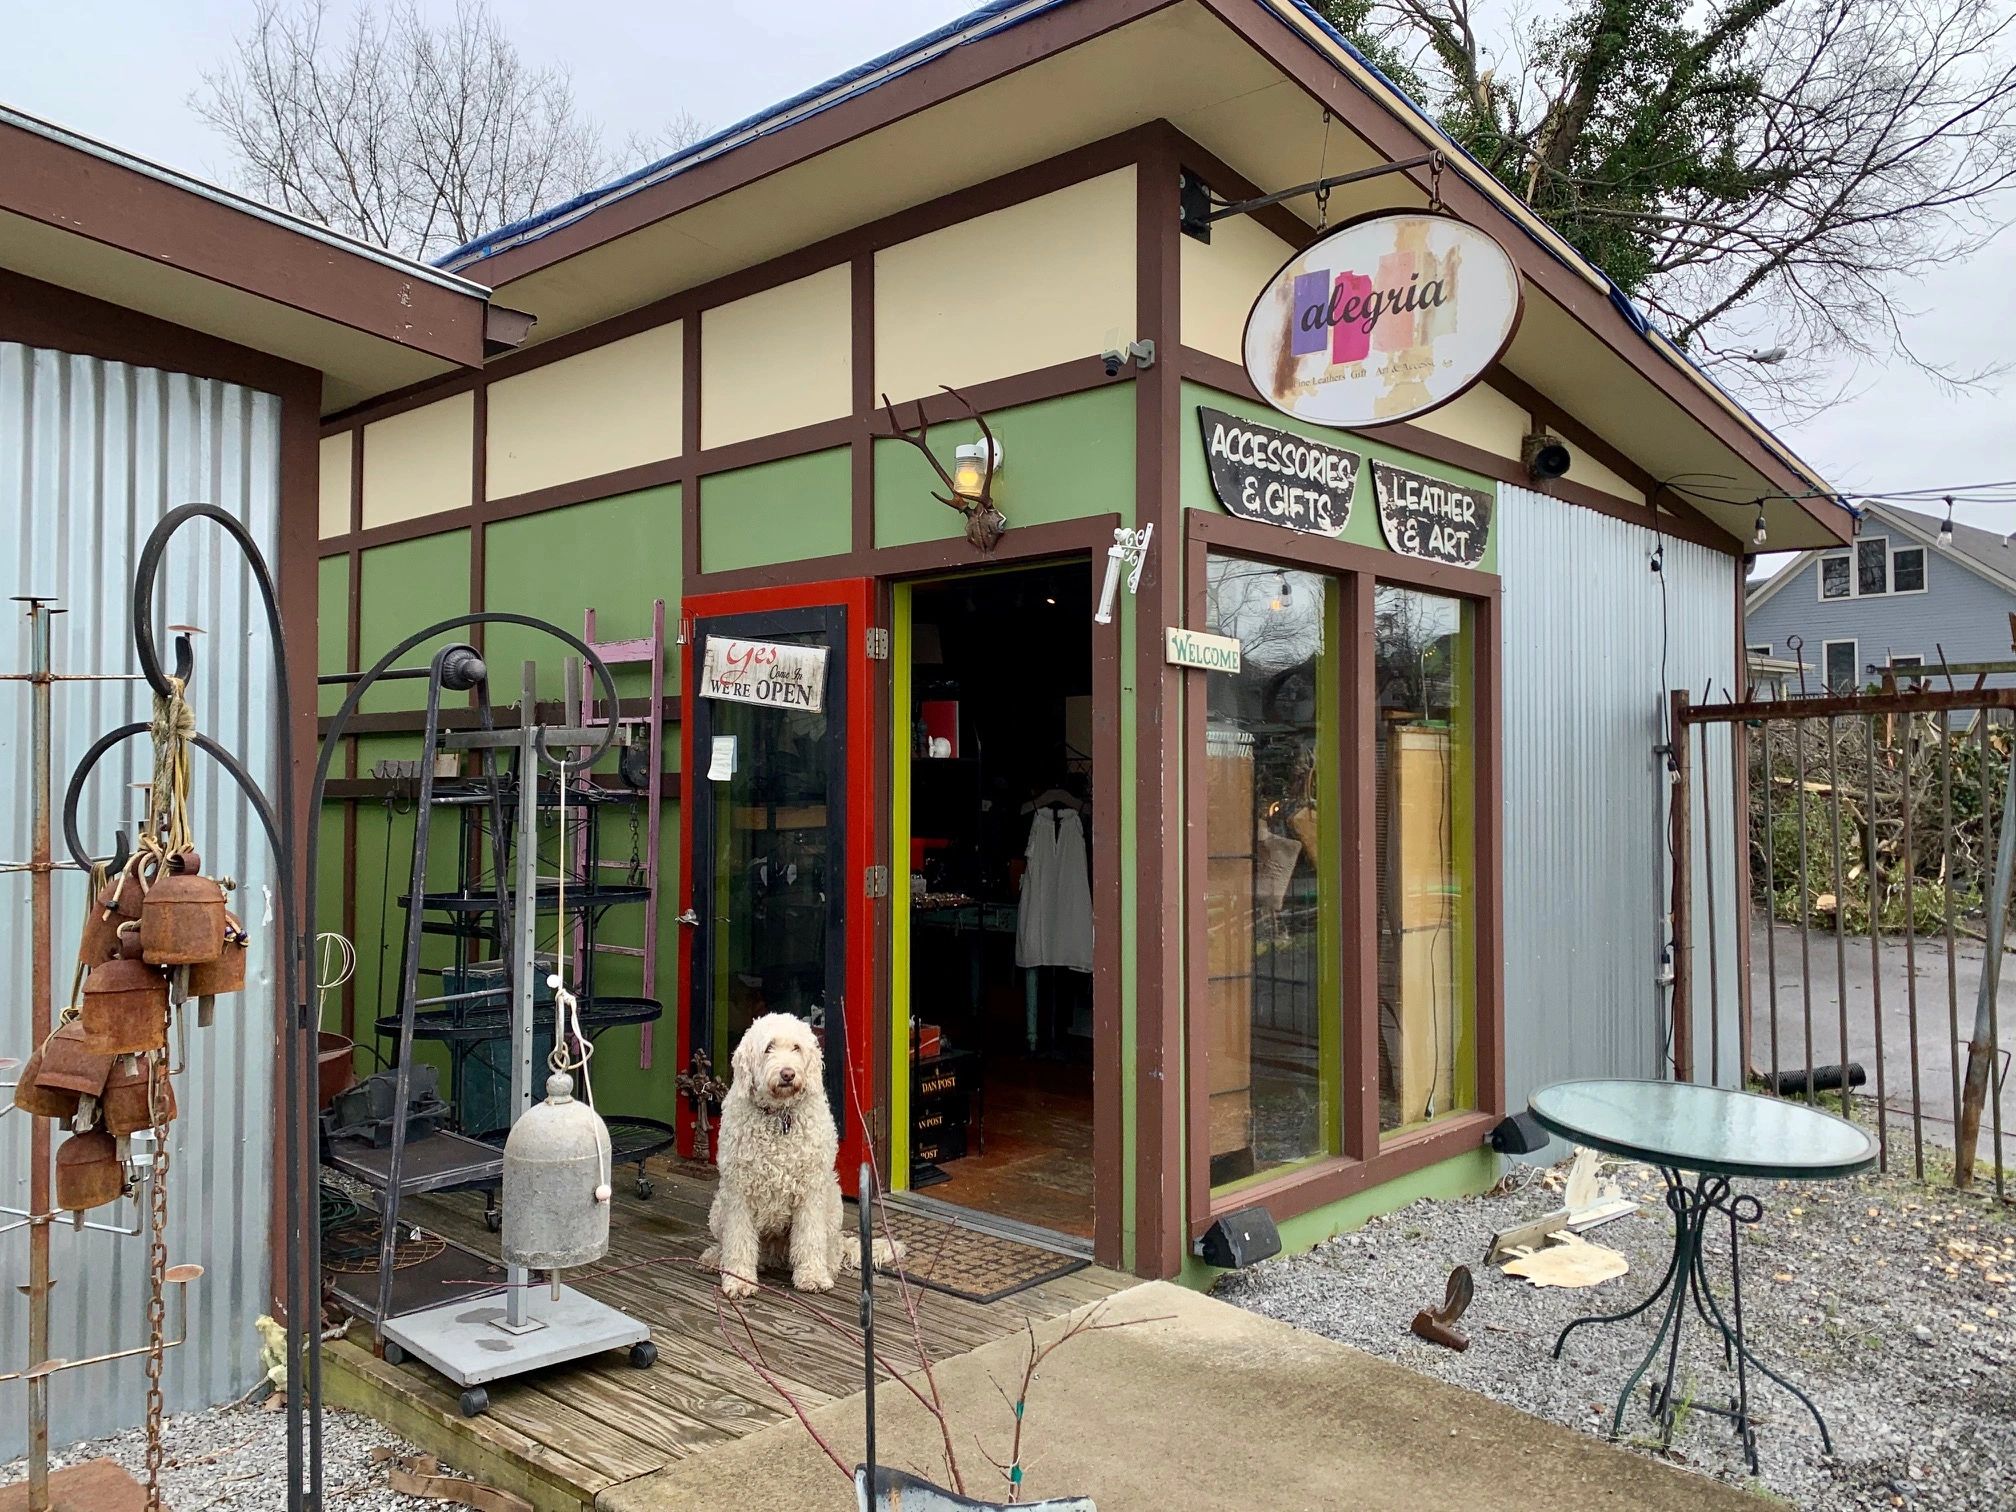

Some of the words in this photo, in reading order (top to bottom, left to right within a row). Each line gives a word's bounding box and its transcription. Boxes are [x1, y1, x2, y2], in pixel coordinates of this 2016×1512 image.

[1300, 272, 1448, 334] alegria
[1312, 373, 1346, 386] Leathers
[1211, 423, 1351, 489] ACCESSORIES
[1242, 476, 1260, 514] &
[1265, 482, 1331, 530] GIFTS
[1392, 476, 1475, 525] LEATHER
[1403, 518, 1420, 549] &
[1429, 527, 1470, 559] ART
[1172, 634, 1239, 670] WELCOME
[769, 664, 790, 680] Come
[791, 667, 803, 680] In
[756, 679, 812, 706] OPEN
[922, 1080, 938, 1093] DAN
[938, 1076, 956, 1090] POST
[927, 1116, 943, 1127] POST
